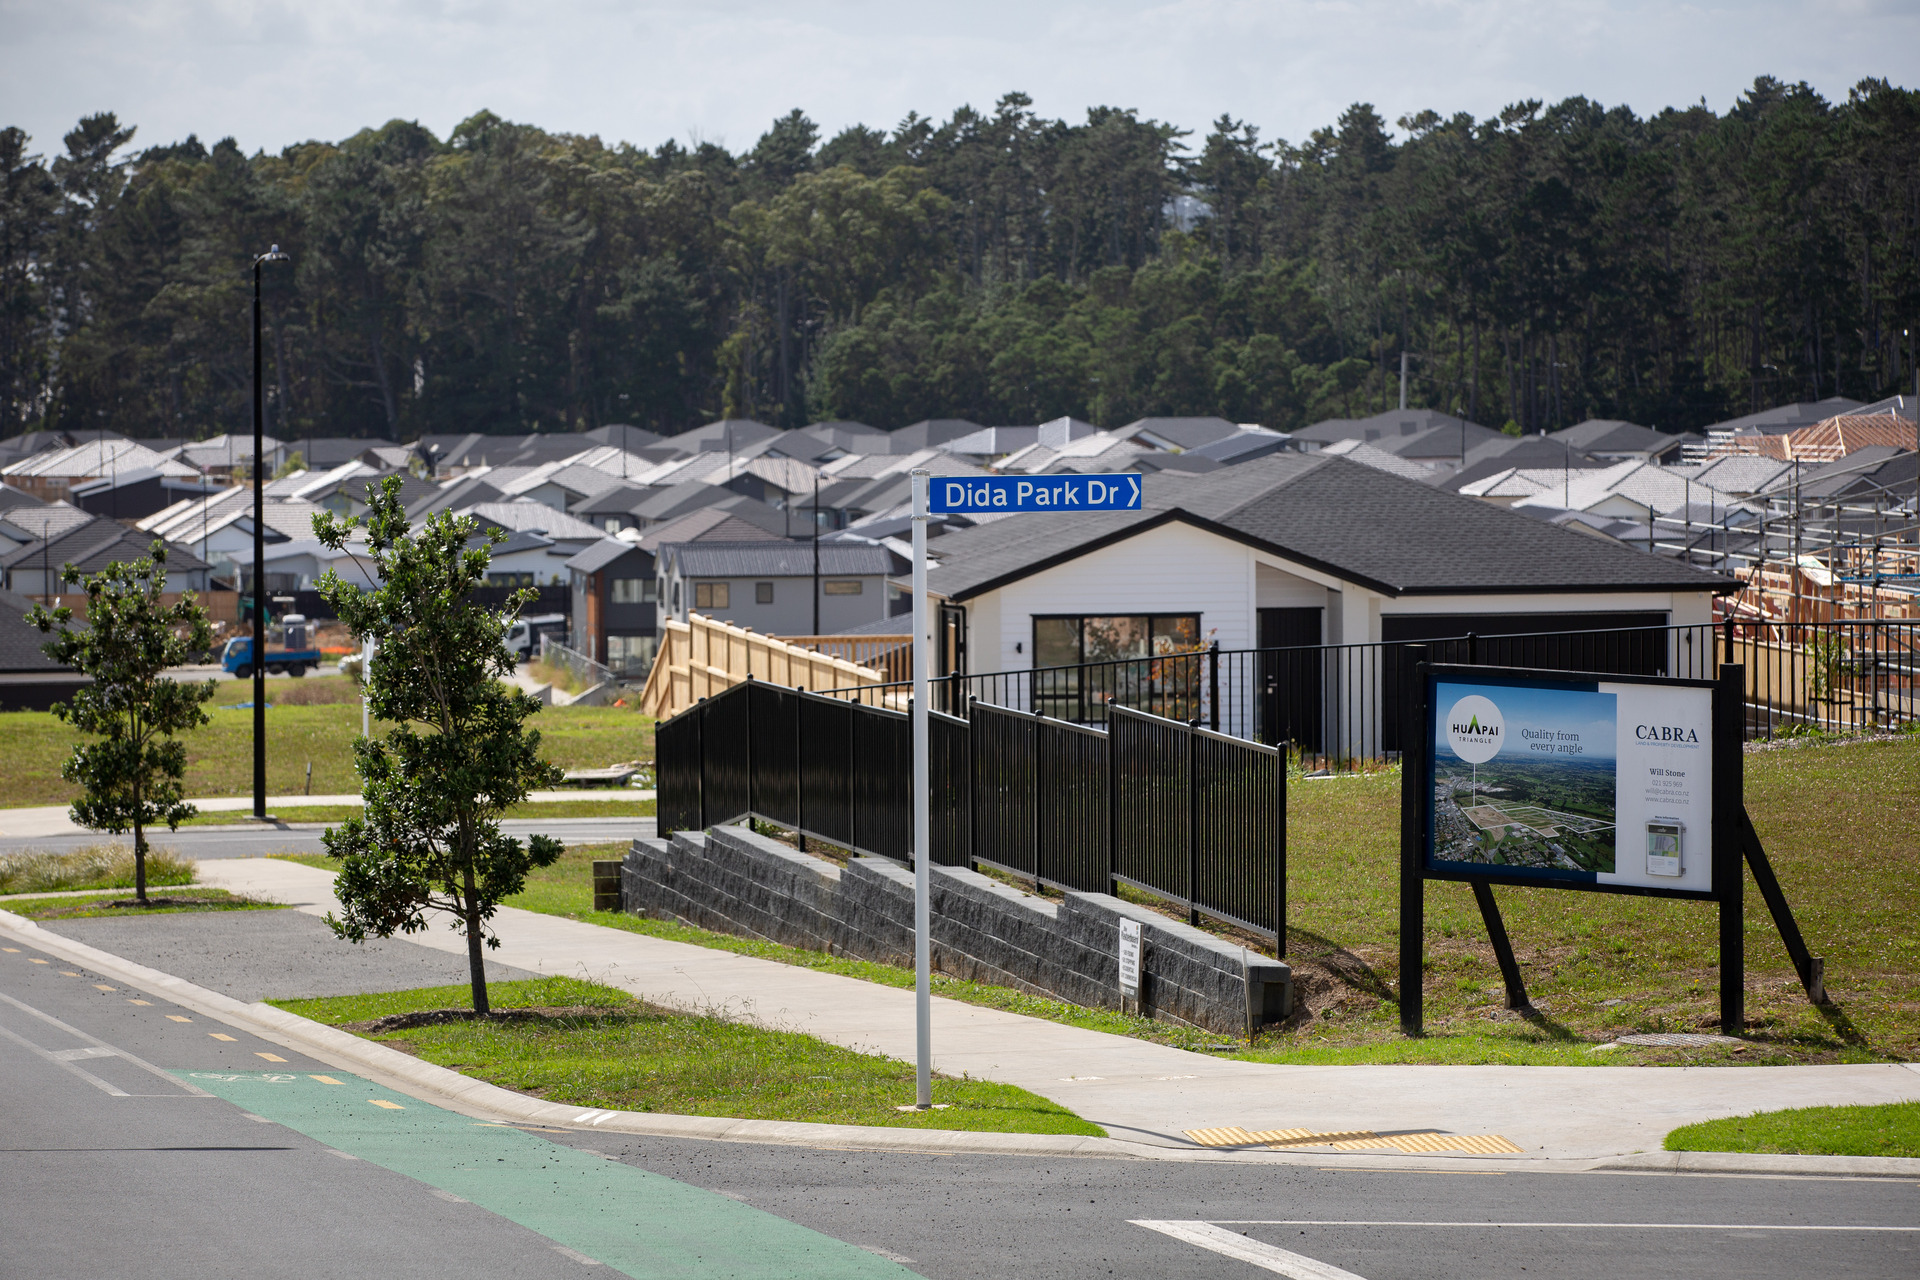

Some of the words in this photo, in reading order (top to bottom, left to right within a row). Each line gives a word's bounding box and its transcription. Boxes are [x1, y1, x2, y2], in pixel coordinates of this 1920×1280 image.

[946, 482, 1008, 507] Dida
[1017, 481, 1080, 506] Park
[1088, 480, 1119, 505] Dr
[1452, 714, 1499, 736] HUAPAI
[1458, 736, 1492, 744] TRIANGLE
[1521, 728, 1555, 742] Quality
[1556, 730, 1580, 742] from
[1635, 724, 1699, 743] CABRA
[1530, 742, 1556, 754] every
[1557, 743, 1583, 756] angle
[1649, 768, 1664, 776] Will
[1665, 769, 1685, 777] Stone
[1645, 787, 1690, 796] will@cabra.co.nz
[1645, 796, 1690, 805] www.cabra.co.nz
